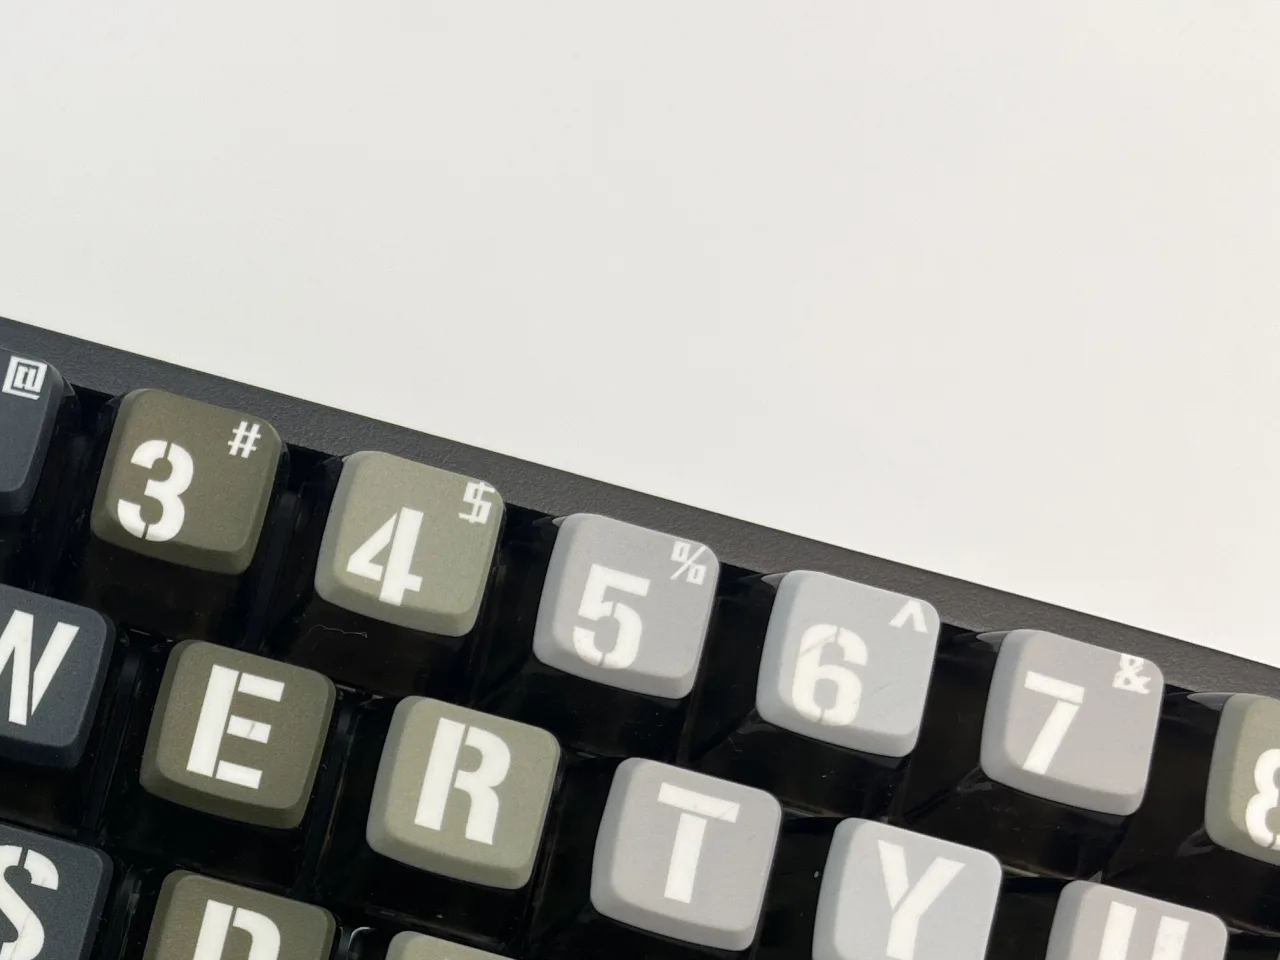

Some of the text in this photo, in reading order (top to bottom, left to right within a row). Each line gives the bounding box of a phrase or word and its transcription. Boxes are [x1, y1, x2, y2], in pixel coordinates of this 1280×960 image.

[2, 356, 48, 400] @
[117, 439, 195, 542] 3
[228, 421, 261, 458] #
[458, 481, 496, 525] $
[346, 507, 424, 606] 4
[670, 541, 706, 585] %
[572, 564, 650, 669] 5
[791, 624, 869, 727] 6
[1022, 671, 1084, 775] 7
[1112, 653, 1151, 695] &
[186, 664, 286, 789] E
[414, 717, 511, 845] R
[657, 782, 740, 905] T
